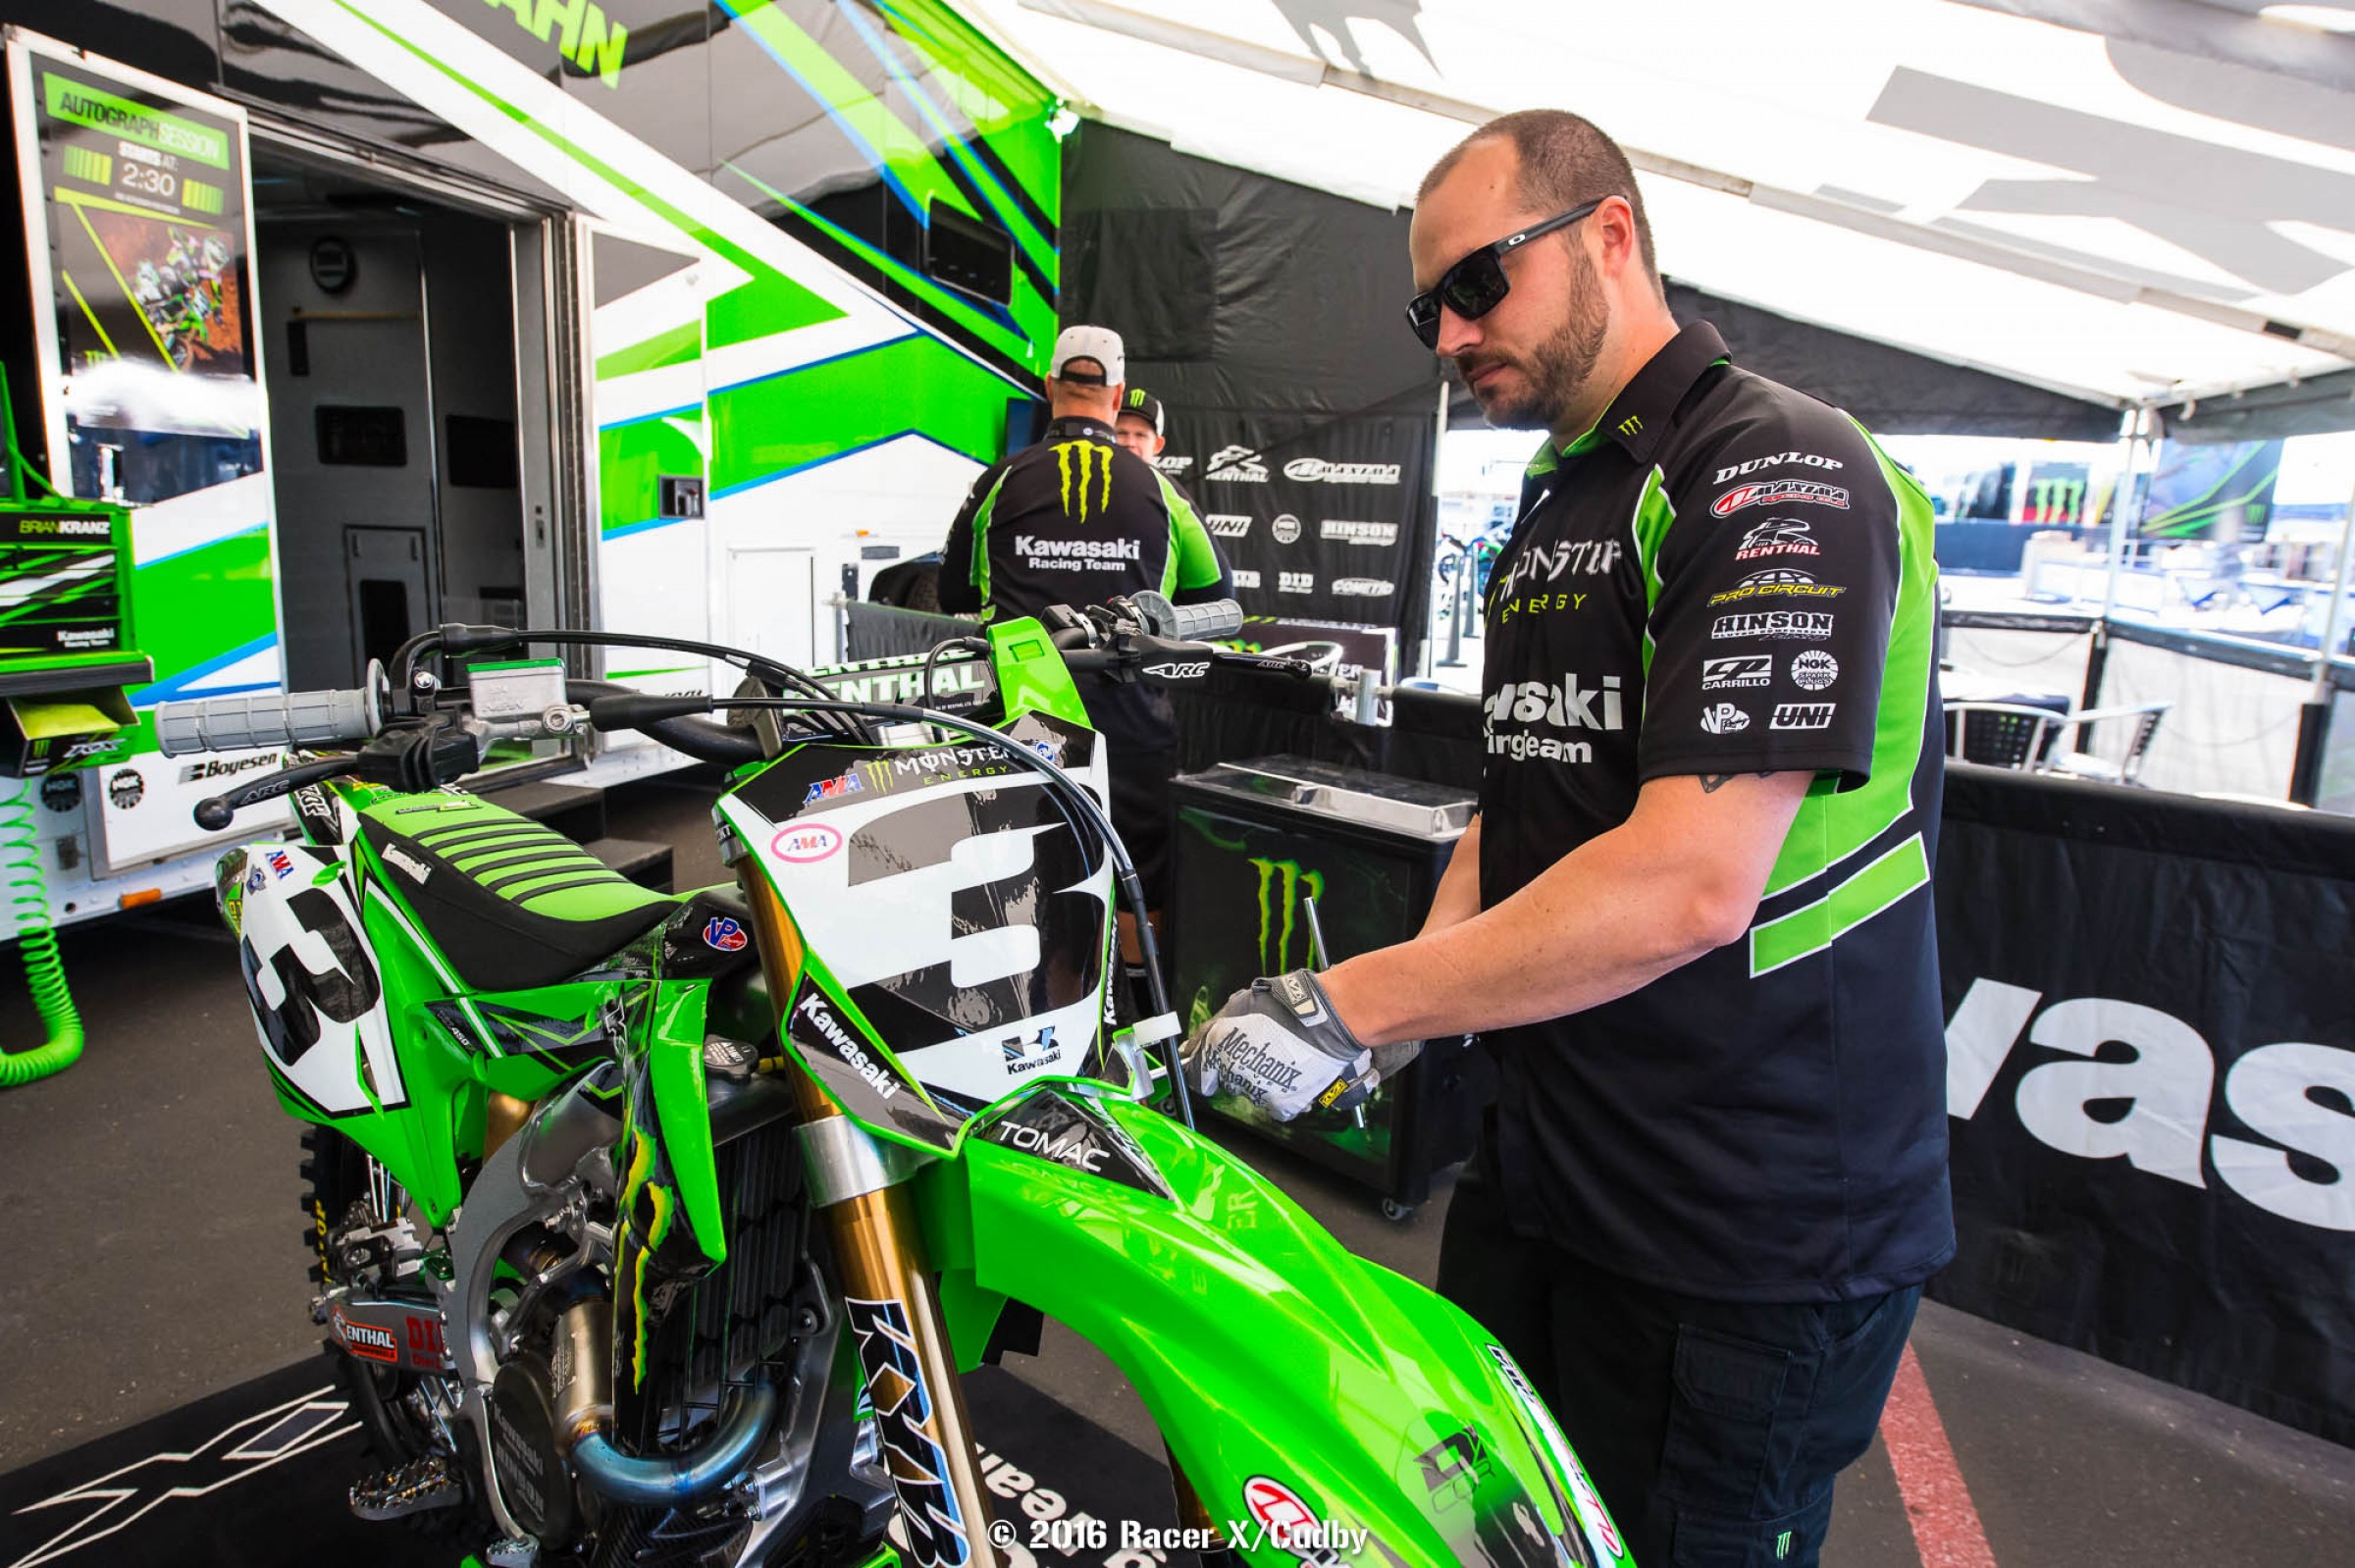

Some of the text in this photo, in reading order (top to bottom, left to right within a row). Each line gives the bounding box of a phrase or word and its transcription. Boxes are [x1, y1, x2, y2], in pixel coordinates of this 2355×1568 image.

[122, 163, 176, 197] 2:30
[1712, 451, 1844, 485] DUNLOP
[1015, 535, 1141, 559] Kawasaki
[1734, 542, 1821, 561] RENTHAL
[1028, 557, 1126, 571] Racing Team
[1707, 583, 1848, 607] PRO CIRCUIT
[1713, 612, 1833, 633] HINSON
[1142, 662, 1211, 679] ARC
[1798, 658, 1831, 670] NGK
[1701, 678, 1771, 691] CARRILLO
[1775, 706, 1831, 727] UNI
[206, 753, 278, 777] Boyesen
[923, 765, 1008, 785] ENERGY
[239, 779, 290, 805] ARC
[804, 773, 864, 805] AMA
[788, 834, 828, 853] AMA
[265, 850, 294, 880] AMA
[848, 782, 1106, 1054] 3
[800, 992, 902, 1100] Kawasaki
[1220, 1026, 1302, 1089] Mechanix
[1007, 1049, 1062, 1075] Kawasaki
[999, 1121, 1111, 1173] TOMAC
